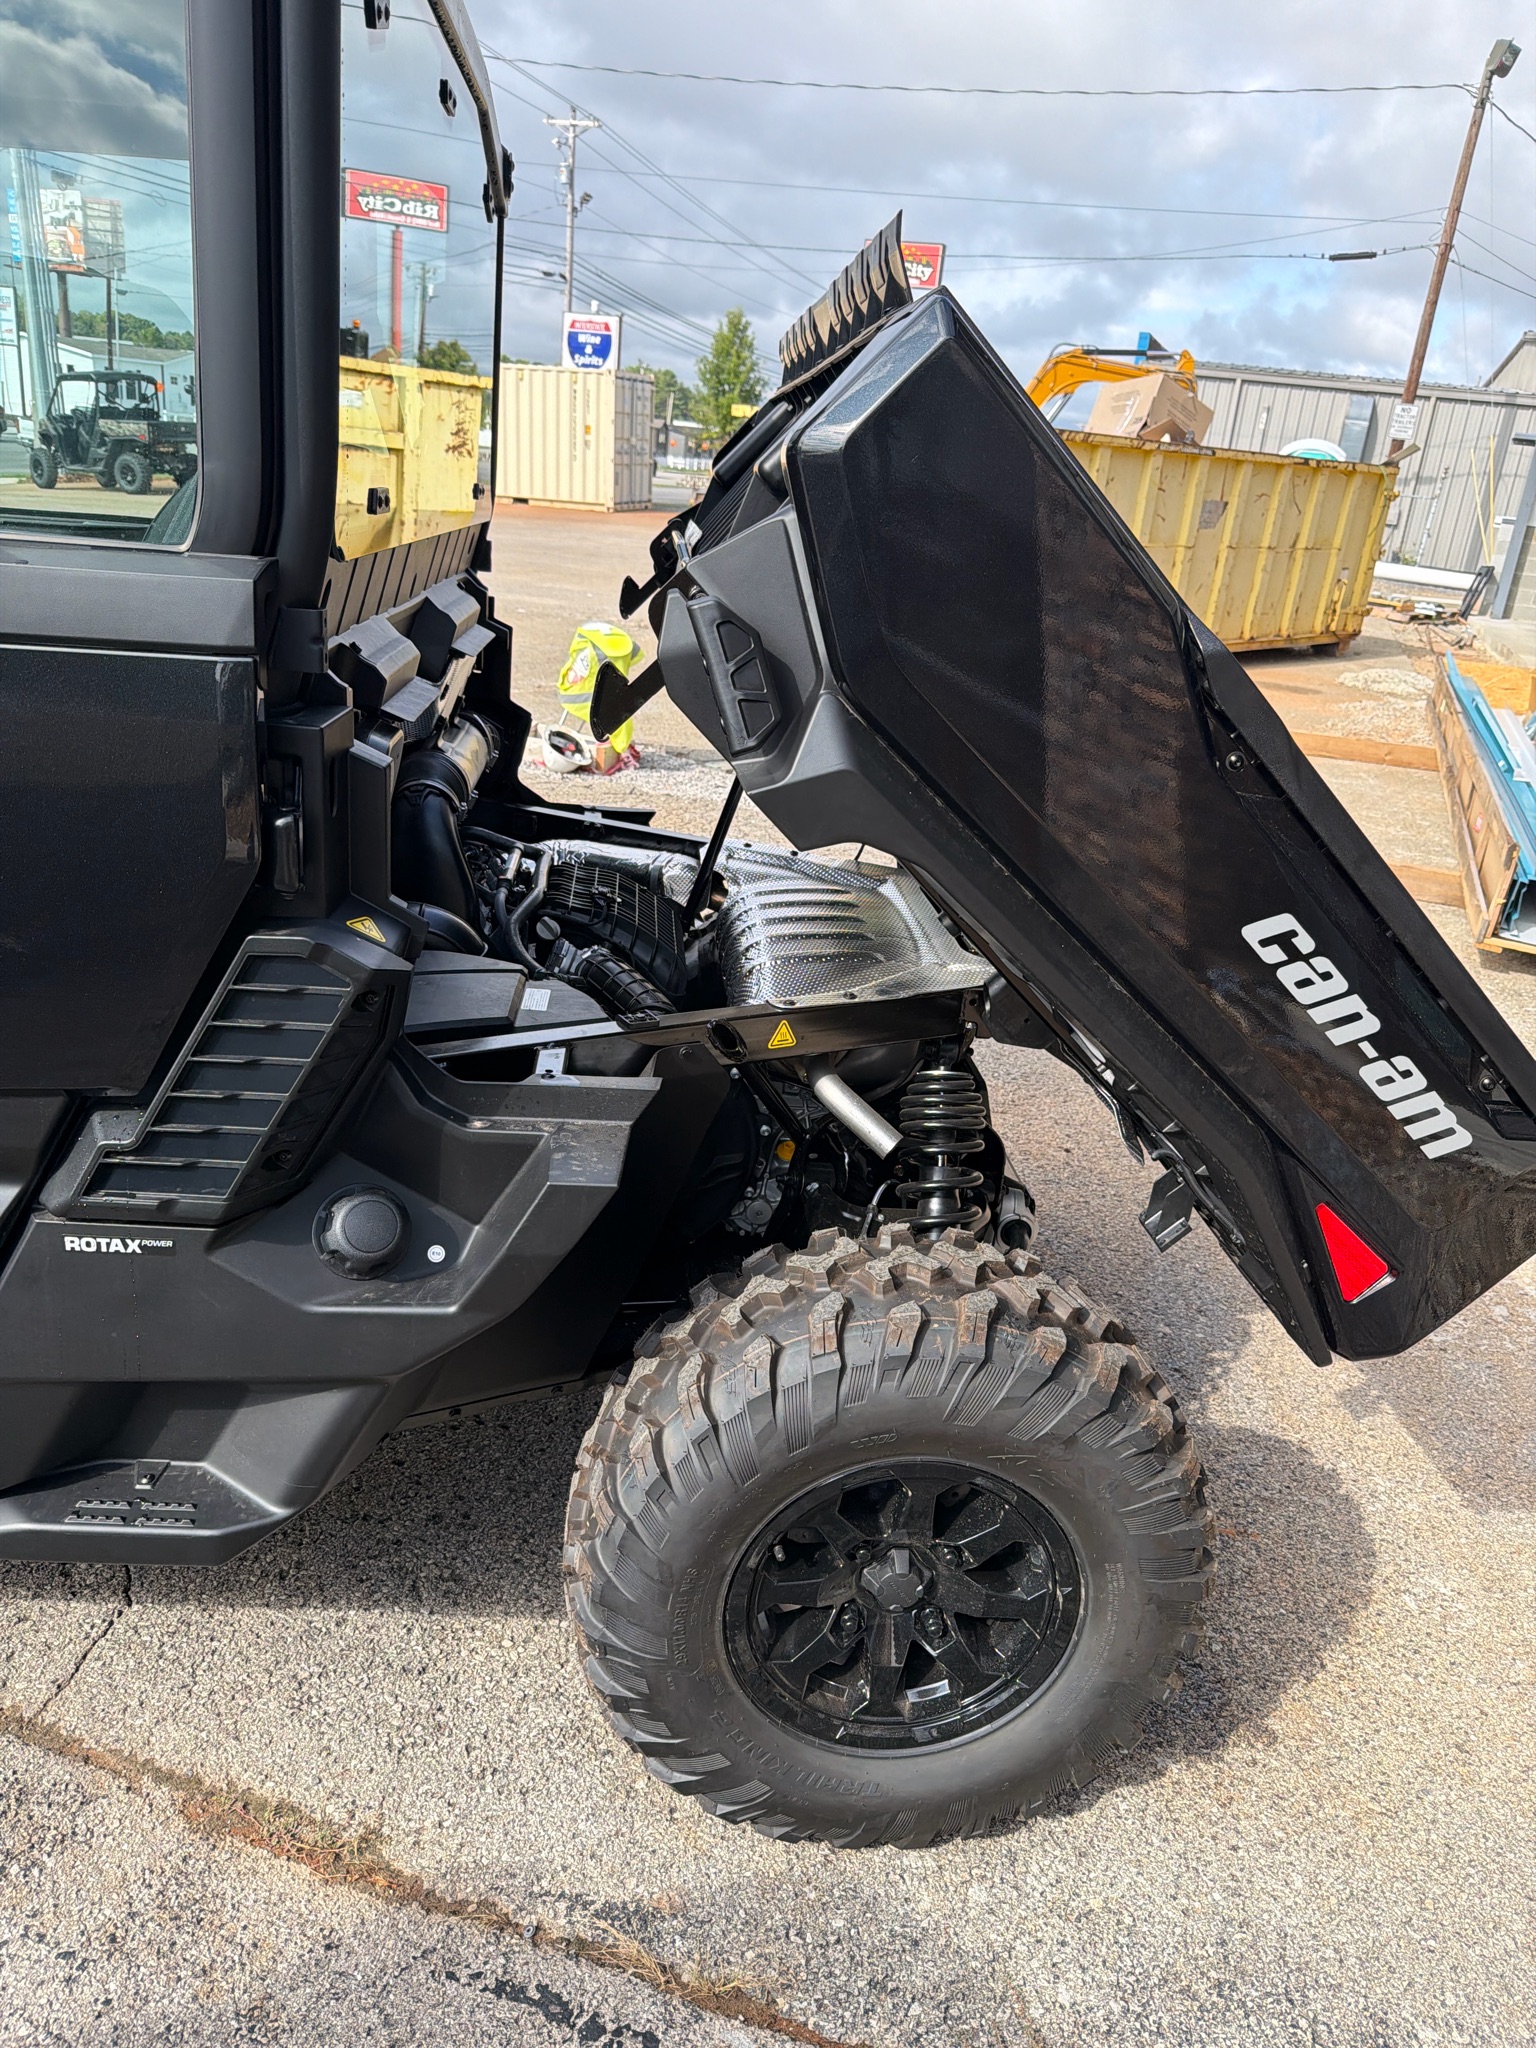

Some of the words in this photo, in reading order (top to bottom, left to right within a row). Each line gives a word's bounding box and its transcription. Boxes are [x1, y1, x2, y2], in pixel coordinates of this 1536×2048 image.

[577, 333, 602, 345] Wine
[584, 344, 593, 355] &
[574, 353, 604, 366] Spirits
[1241, 912, 1474, 1160] can-am
[63, 1236, 143, 1254] ROTAX
[141, 1239, 173, 1248] POWER
[726, 1728, 794, 1776] KING
